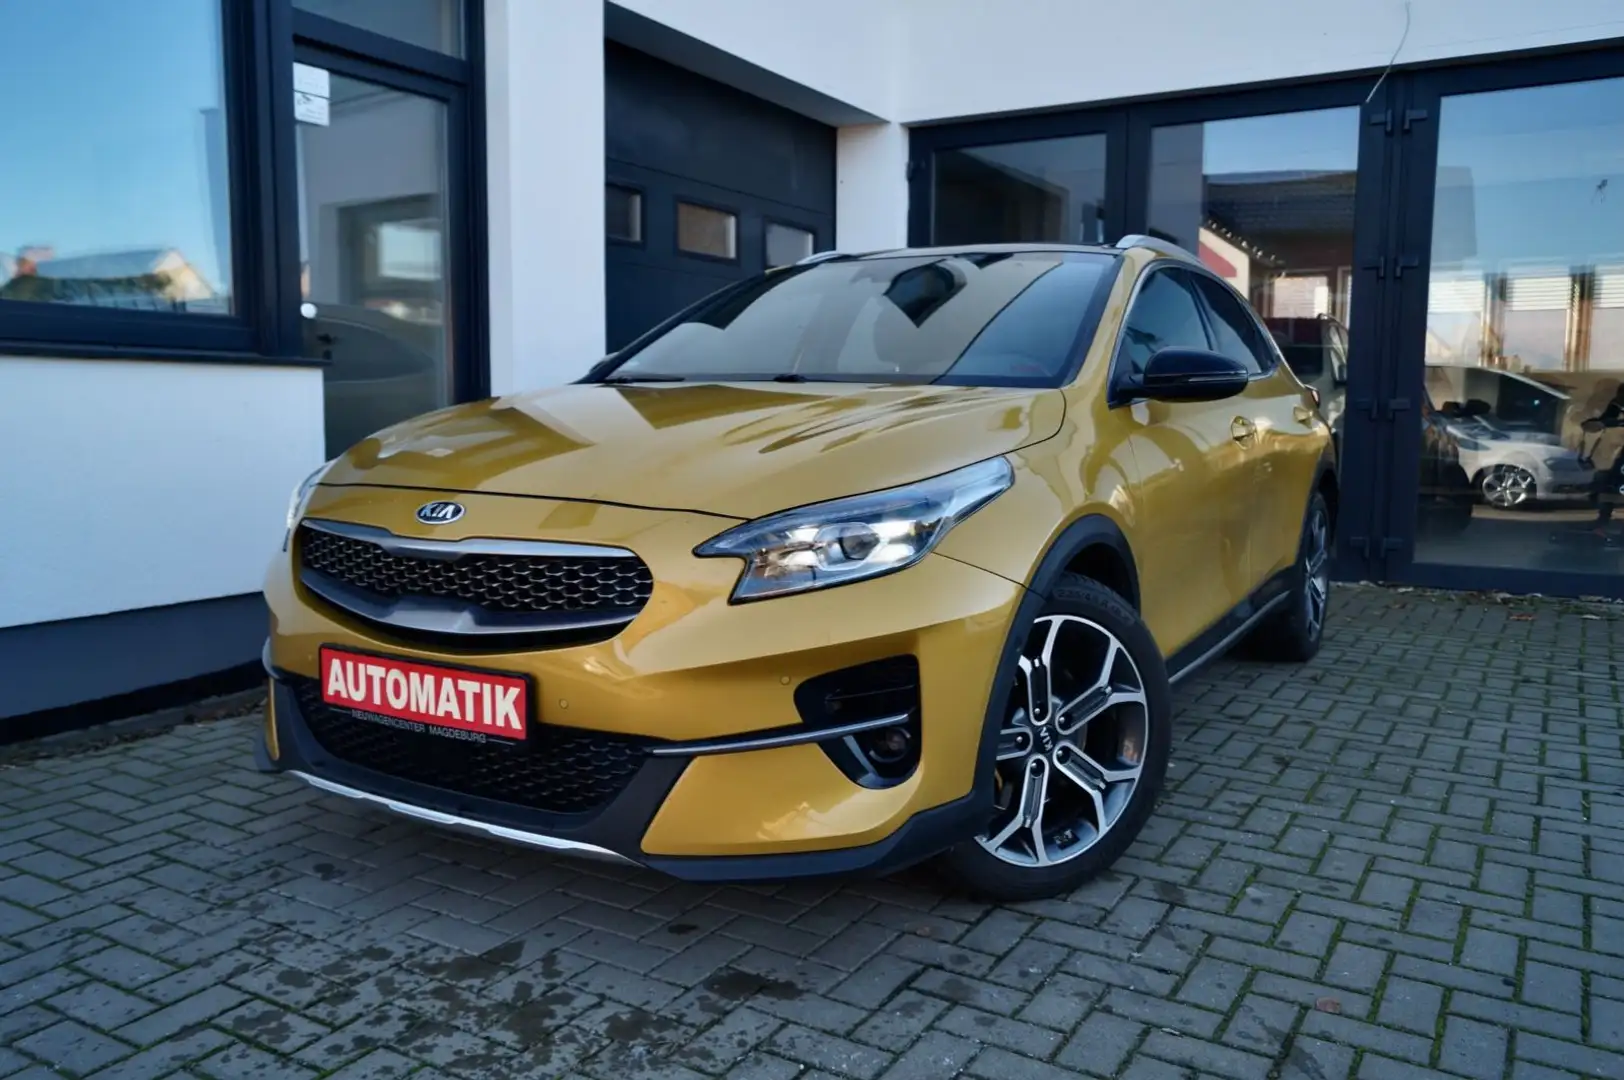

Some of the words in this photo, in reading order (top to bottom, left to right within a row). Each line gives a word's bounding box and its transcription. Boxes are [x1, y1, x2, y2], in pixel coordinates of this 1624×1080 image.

[420, 503, 456, 519] KIA
[327, 658, 523, 730] AUTOMATIK
[352, 709, 425, 733] NEUWAGENCENTER
[429, 725, 487, 743] MAGDEBURG
[1038, 726, 1054, 751] KIA
